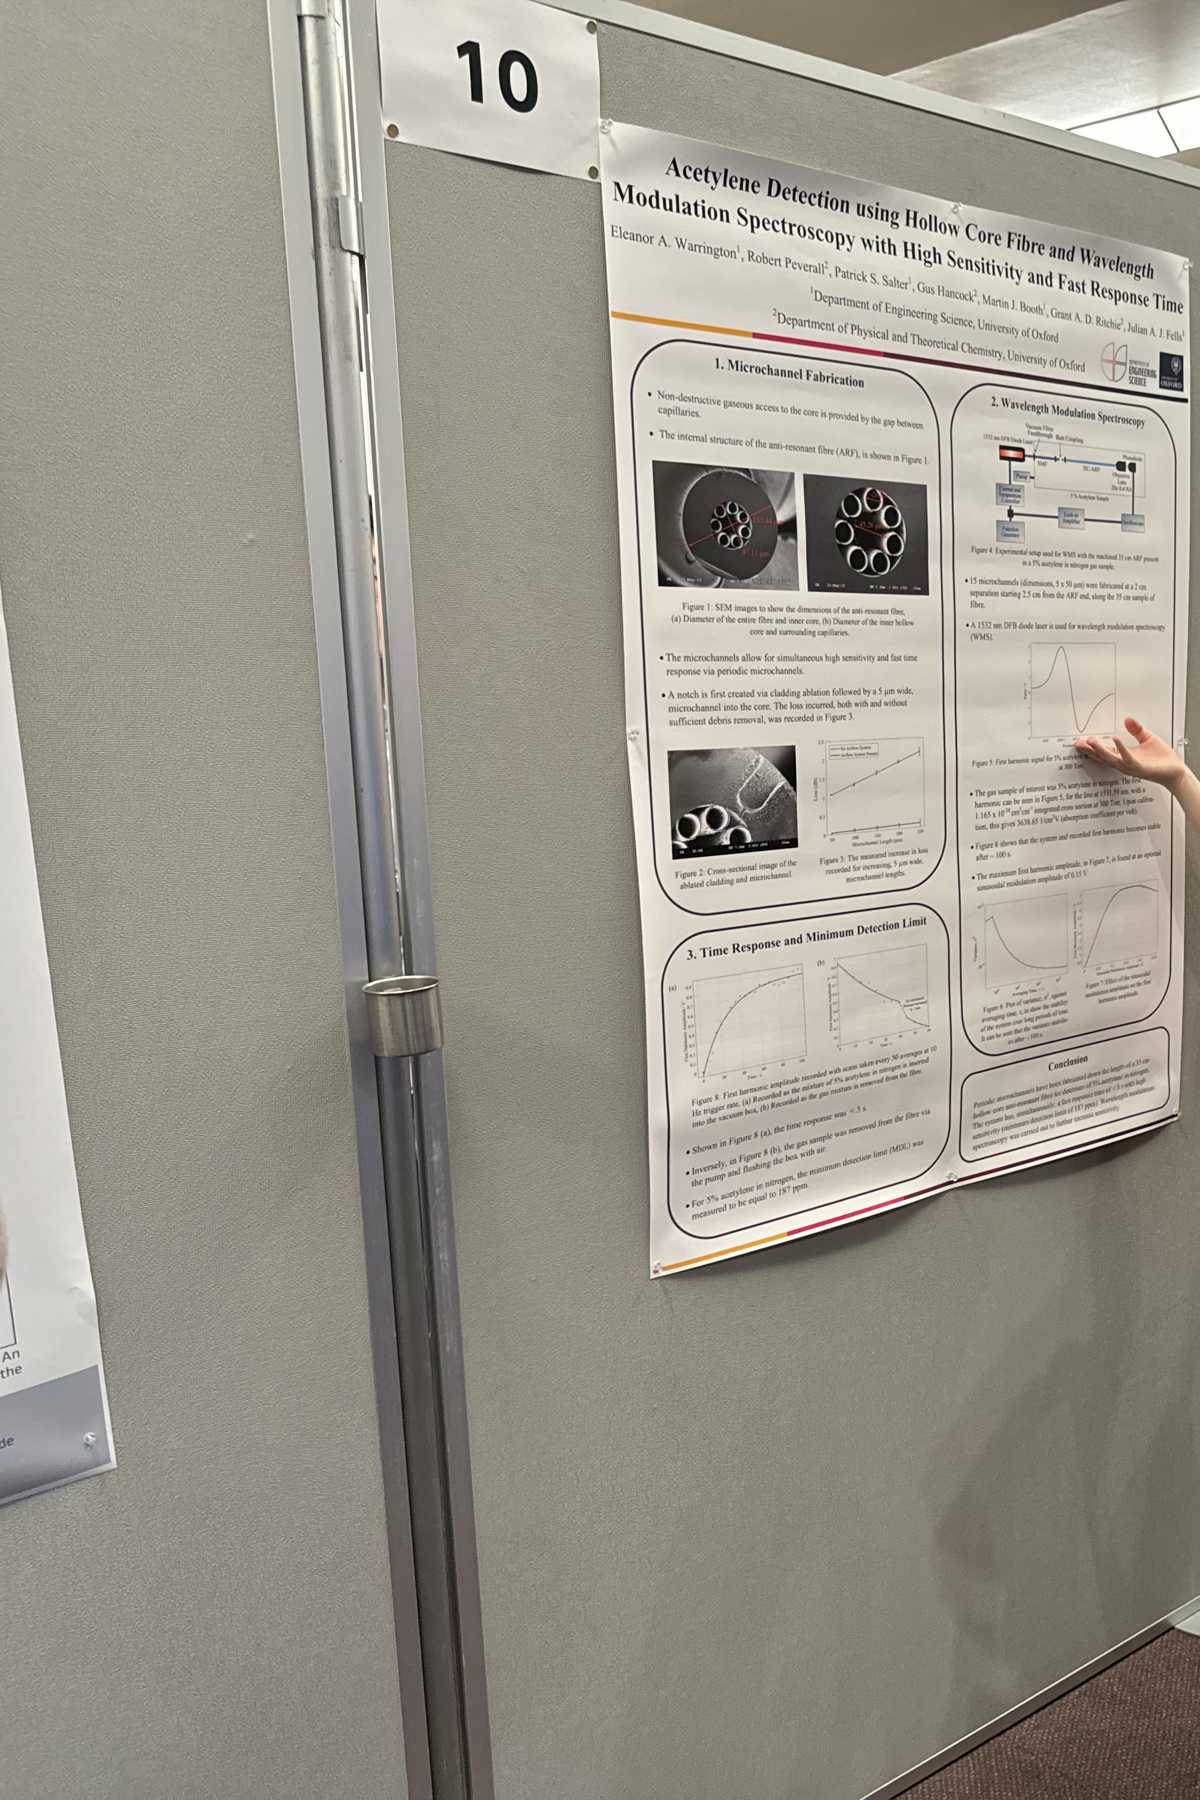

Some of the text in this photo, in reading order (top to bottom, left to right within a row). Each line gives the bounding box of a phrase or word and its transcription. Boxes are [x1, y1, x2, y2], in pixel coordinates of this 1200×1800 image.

[456, 40, 538, 113] 10
[665, 156, 1154, 281] Acetylene Detection using Hollow Core Fibre and Wavelength
[612, 182, 1184, 315] Modulation Spectroscopy with High Sensitivity and Fast Response Time
[610, 225, 655, 245] Eleanor
[657, 233, 671, 248] A.
[747, 249, 782, 267] Robert
[835, 266, 868, 283] Patrick
[870, 273, 879, 285] S.
[917, 280, 935, 294] Gus
[982, 293, 1009, 309] Martin
[1051, 307, 1072, 321] Grant
[1074, 312, 1083, 323] A.
[1085, 314, 1094, 325] D.
[1127, 321, 1148, 335] Julian
[872, 301, 882, 313] of
[885, 303, 938, 326] Engineering
[940, 313, 976, 331] Science,
[977, 319, 1019, 340] University
[1021, 328, 1030, 339] of
[1031, 329, 1059, 343] Oxford
[837, 323, 848, 335] of
[850, 324, 889, 341] Physical
[891, 332, 908, 344] and
[910, 334, 959, 352] Theoretical
[960, 341, 1006, 361] Chemistry,
[1007, 349, 1047, 369] University
[1049, 358, 1058, 368] of
[1059, 359, 1086, 373] Oxford
[715, 359, 865, 388] 1. Microchannel Fabrication
[992, 397, 1145, 428] 2. Wavelength Modulation Spectroscopy
[666, 653, 681, 662] The
[683, 653, 740, 662] microchannels
[741, 654, 762, 662] allow
[764, 654, 775, 662] for
[825, 654, 840, 664] high
[877, 654, 889, 662] and
[666, 669, 701, 678] response
[703, 667, 715, 675] via
[717, 666, 748, 677] periodic
[668, 690, 675, 699] A
[677, 690, 700, 699] notch
[701, 690, 708, 698] is
[710, 690, 726, 698] first
[727, 689, 755, 698] created
[757, 689, 768, 698] via
[770, 689, 800, 699] cladding
[802, 688, 830, 697] ablation
[832, 688, 861, 696] followed
[862, 688, 871, 697] by
[688, 917, 927, 961] 3. Time Response and Minimum Detection Limit
[1048, 1056, 1088, 1071] Conclusion
[692, 1143, 718, 1154] Shown
[719, 1139, 727, 1148] in
[729, 1135, 752, 1145] Figure
[774, 1126, 785, 1135] the
[803, 1116, 832, 1128] response
[834, 1112, 847, 1120] was
[692, 1206, 727, 1220] measured
[729, 1205, 736, 1213] to
[738, 1200, 747, 1209] be
[749, 1193, 768, 1206] equal
[778, 1189, 791, 1198] 187
[792, 1184, 808, 1197] ppm
[2, 1350, 20, 1362] An
